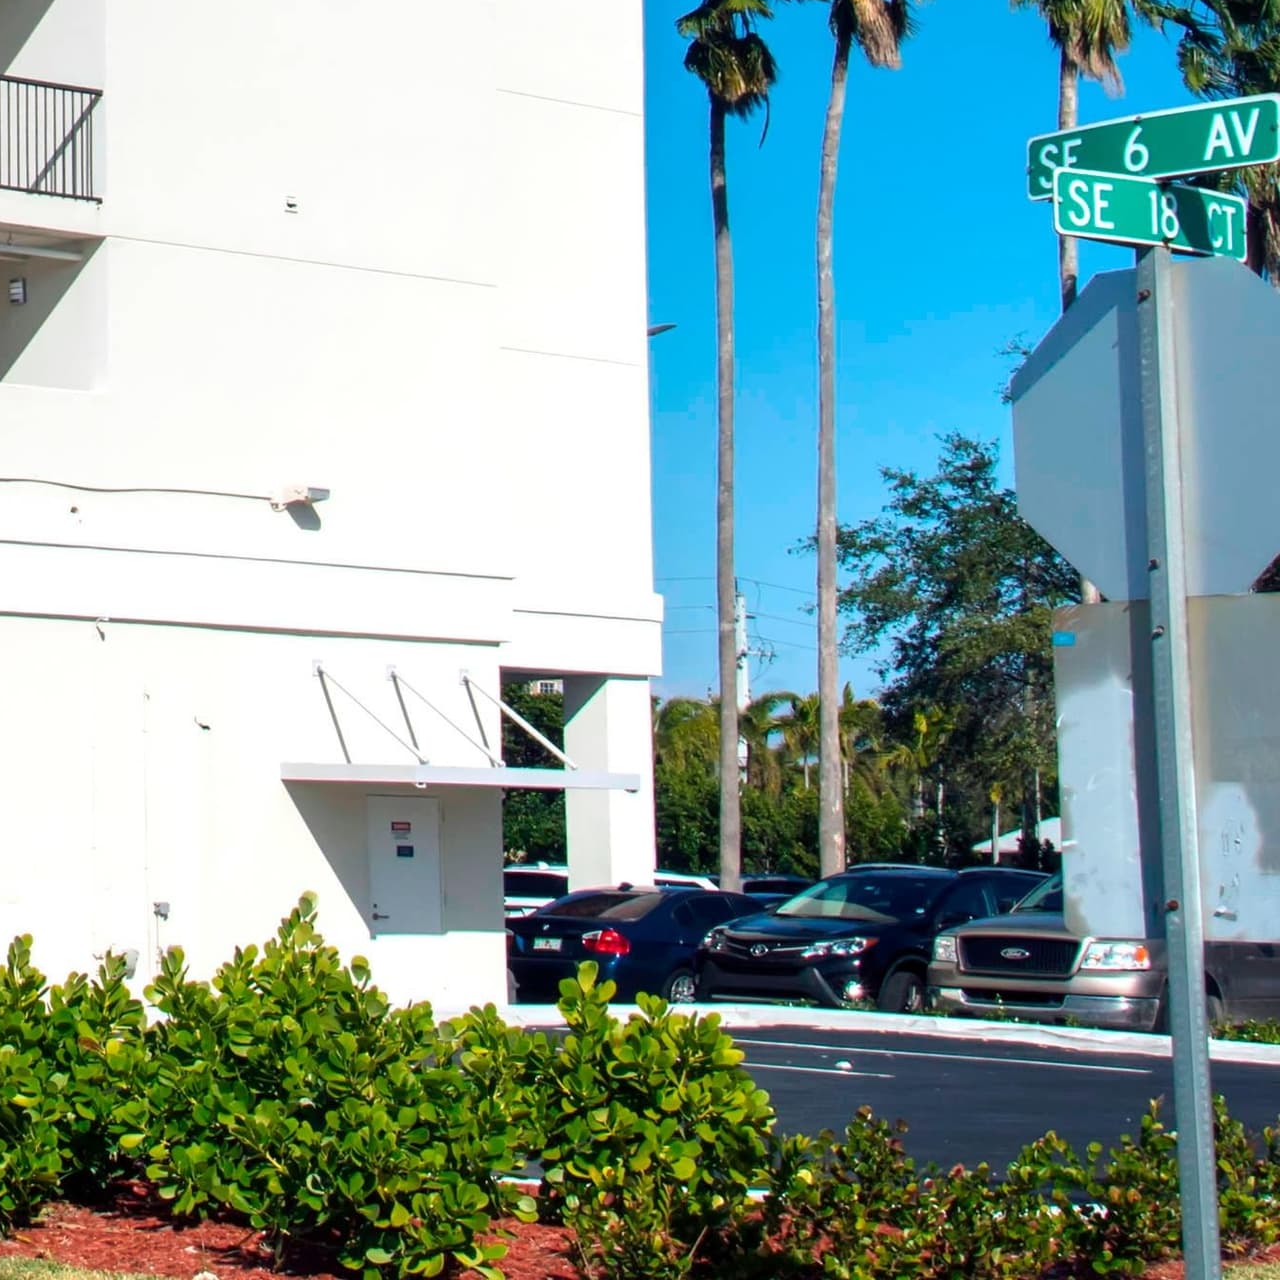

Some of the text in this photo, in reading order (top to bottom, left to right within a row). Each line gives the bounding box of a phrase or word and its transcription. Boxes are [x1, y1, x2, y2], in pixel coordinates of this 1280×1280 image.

[1123, 125, 1149, 173] 6
[1203, 108, 1260, 161] AV
[1068, 180, 1236, 251] SE 18 CT
